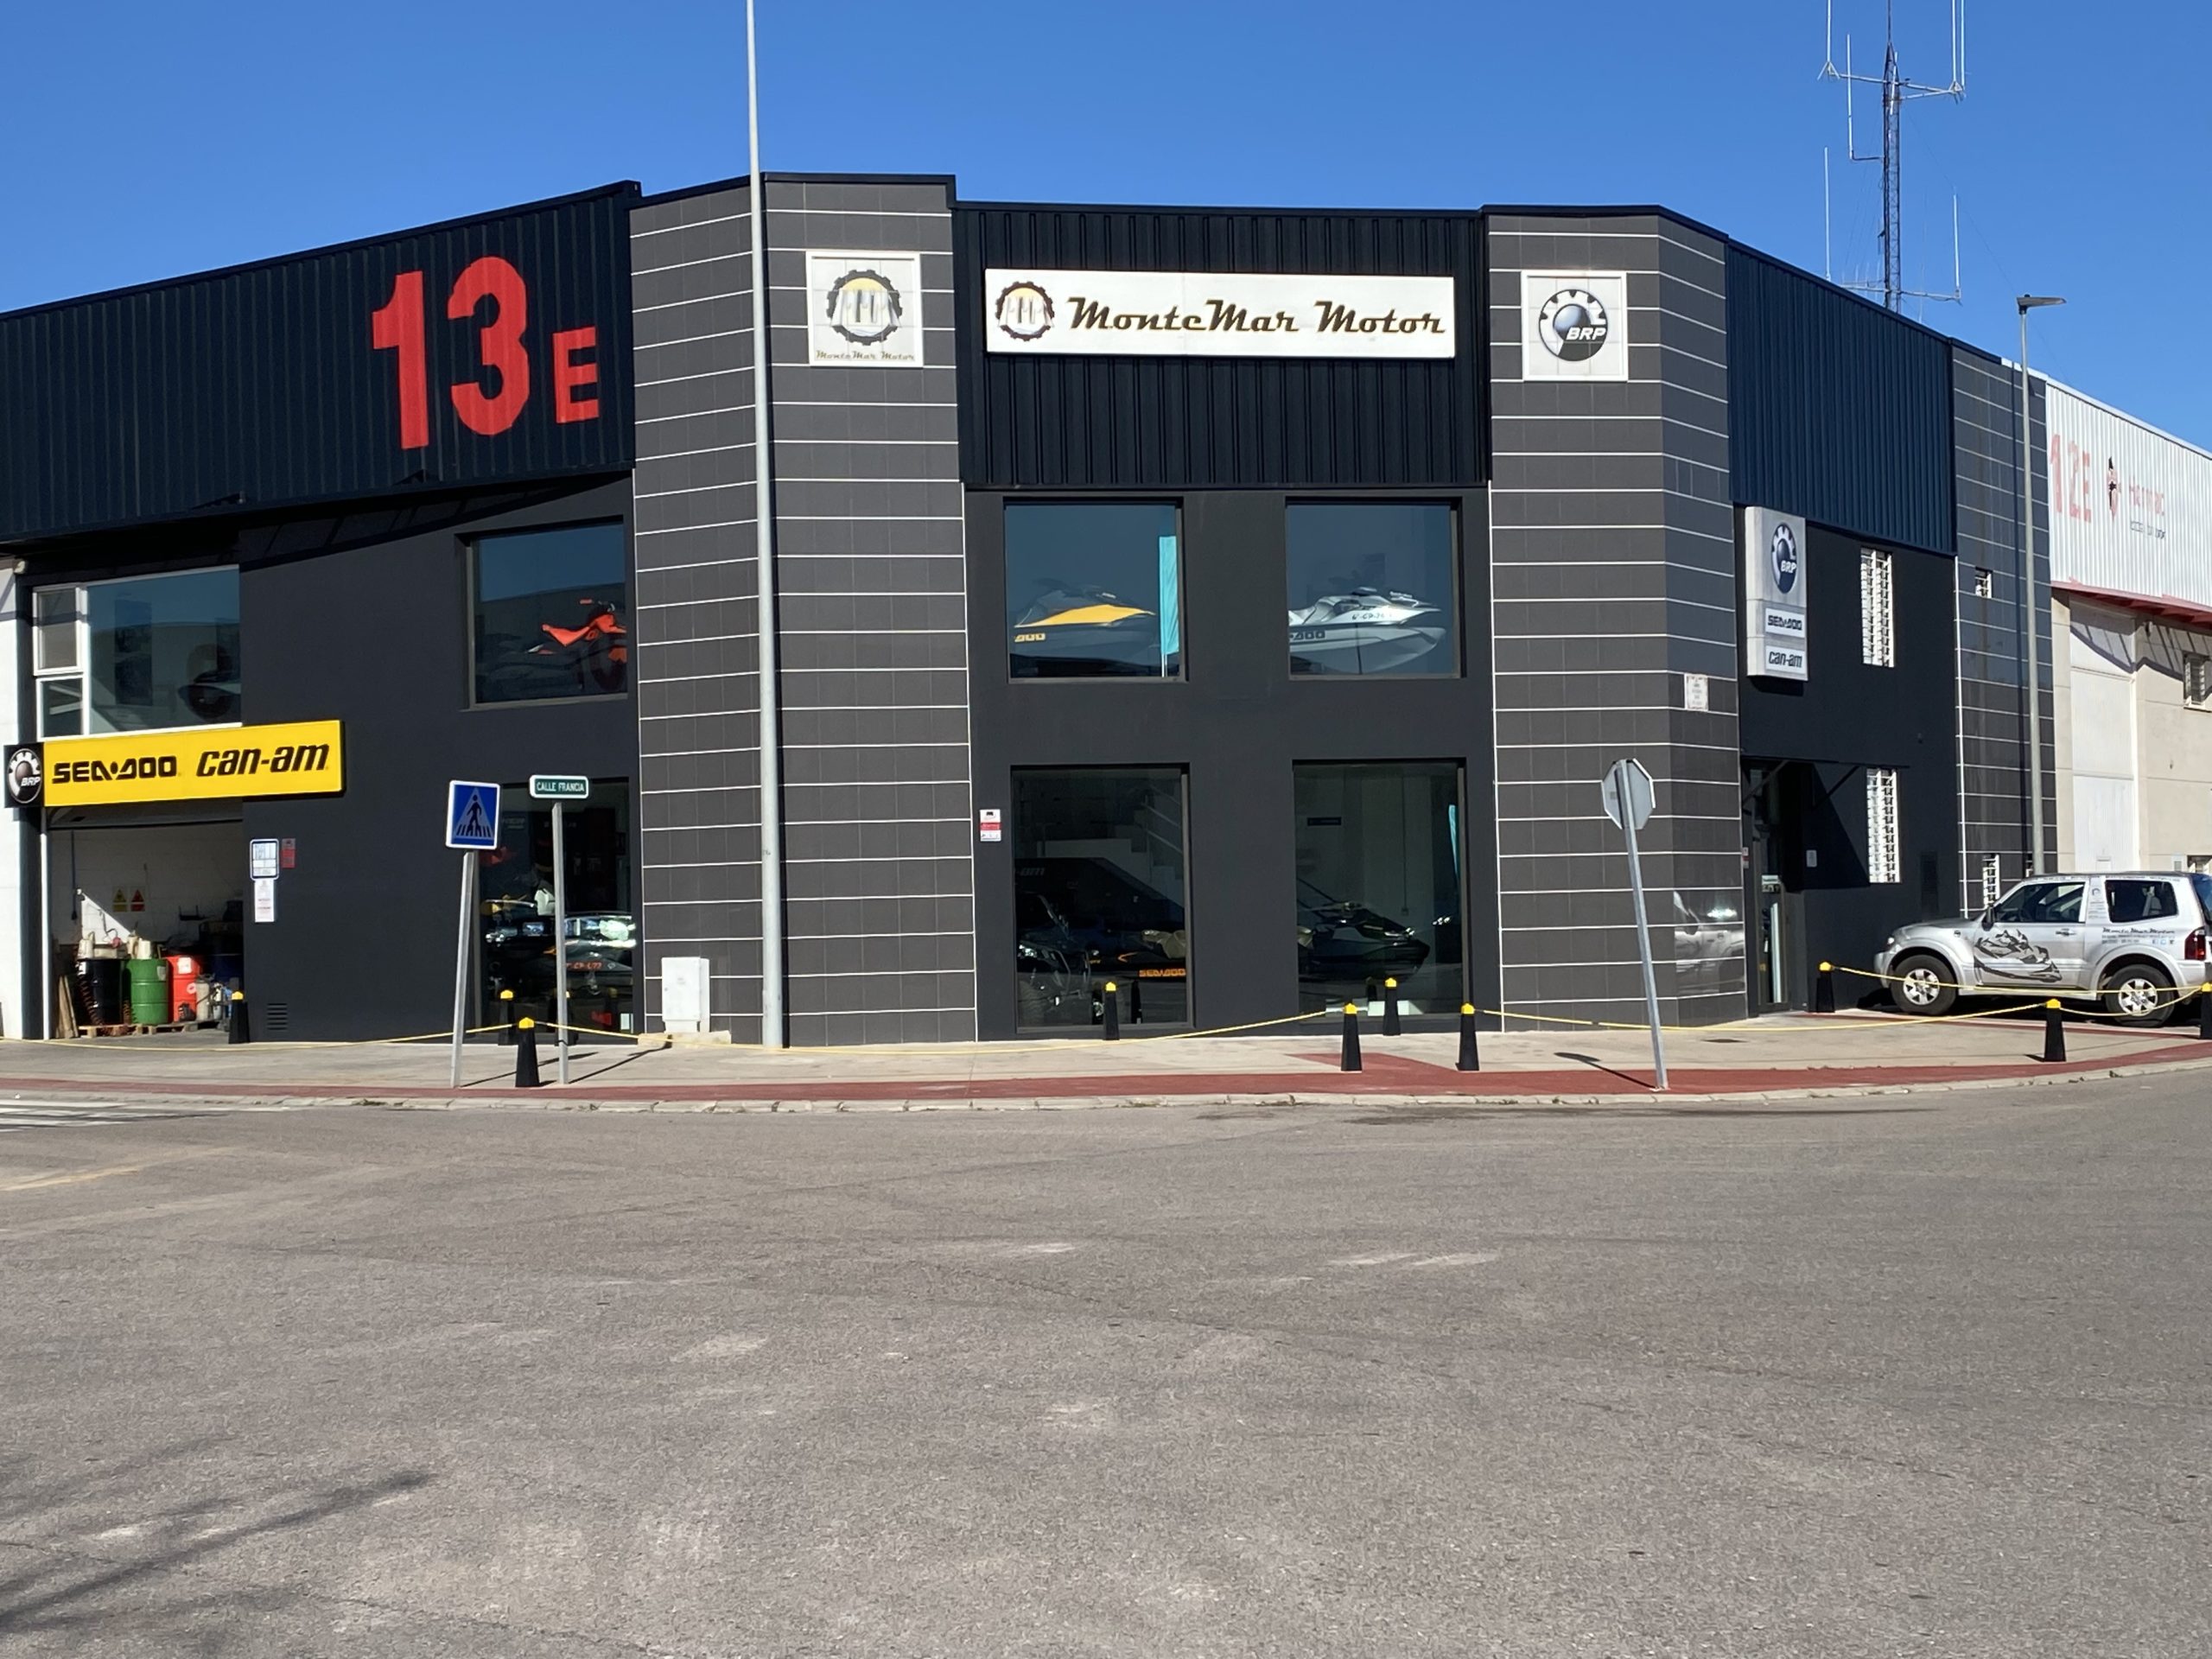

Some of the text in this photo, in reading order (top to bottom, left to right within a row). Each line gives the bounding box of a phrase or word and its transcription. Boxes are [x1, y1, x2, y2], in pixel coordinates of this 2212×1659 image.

[1313, 300, 1446, 334] Motor
[1566, 327, 1607, 340] BRP
[1781, 560, 1798, 574] BRP
[1768, 652, 1802, 668] can-am
[196, 744, 329, 777] can-am
[21, 776, 41, 787] BRP
[537, 781, 585, 792] CALLE FRANCIA
